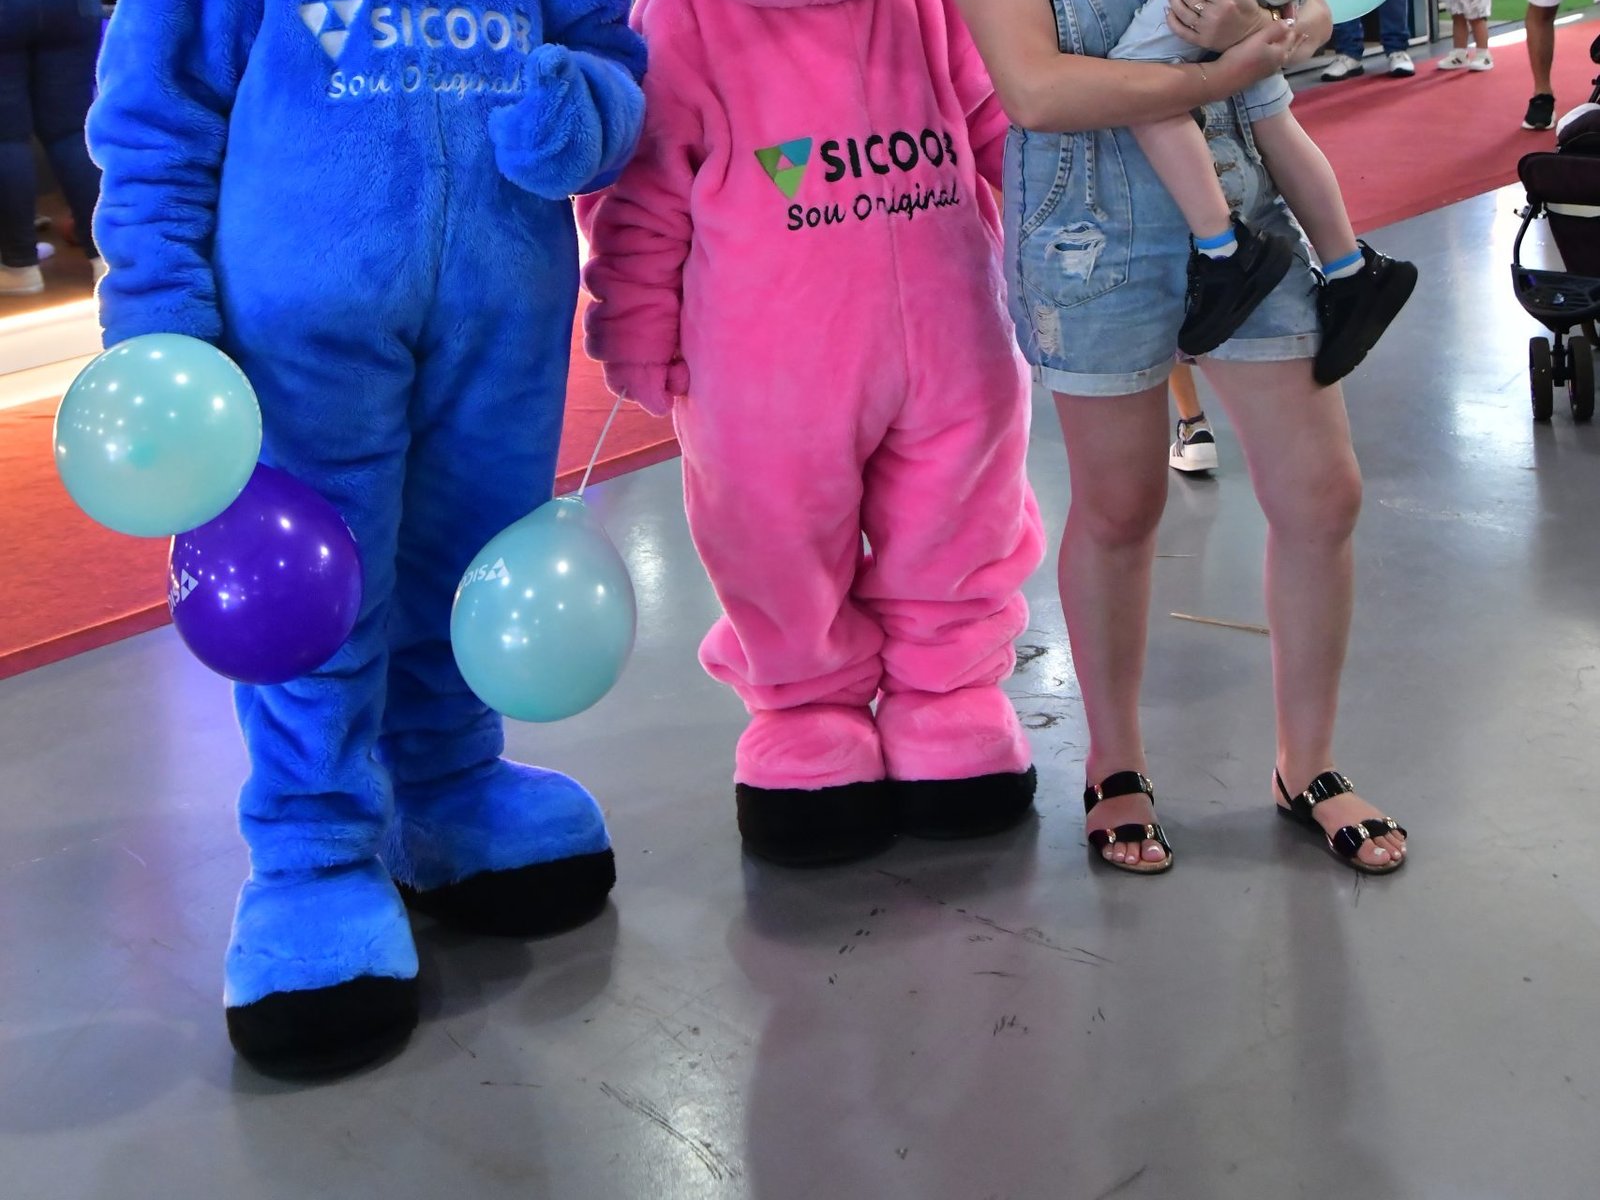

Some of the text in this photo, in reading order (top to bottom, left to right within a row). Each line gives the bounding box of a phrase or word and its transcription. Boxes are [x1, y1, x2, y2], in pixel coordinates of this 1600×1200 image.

[328, 68, 392, 99] Sou
[786, 178, 960, 232] Sou Original
